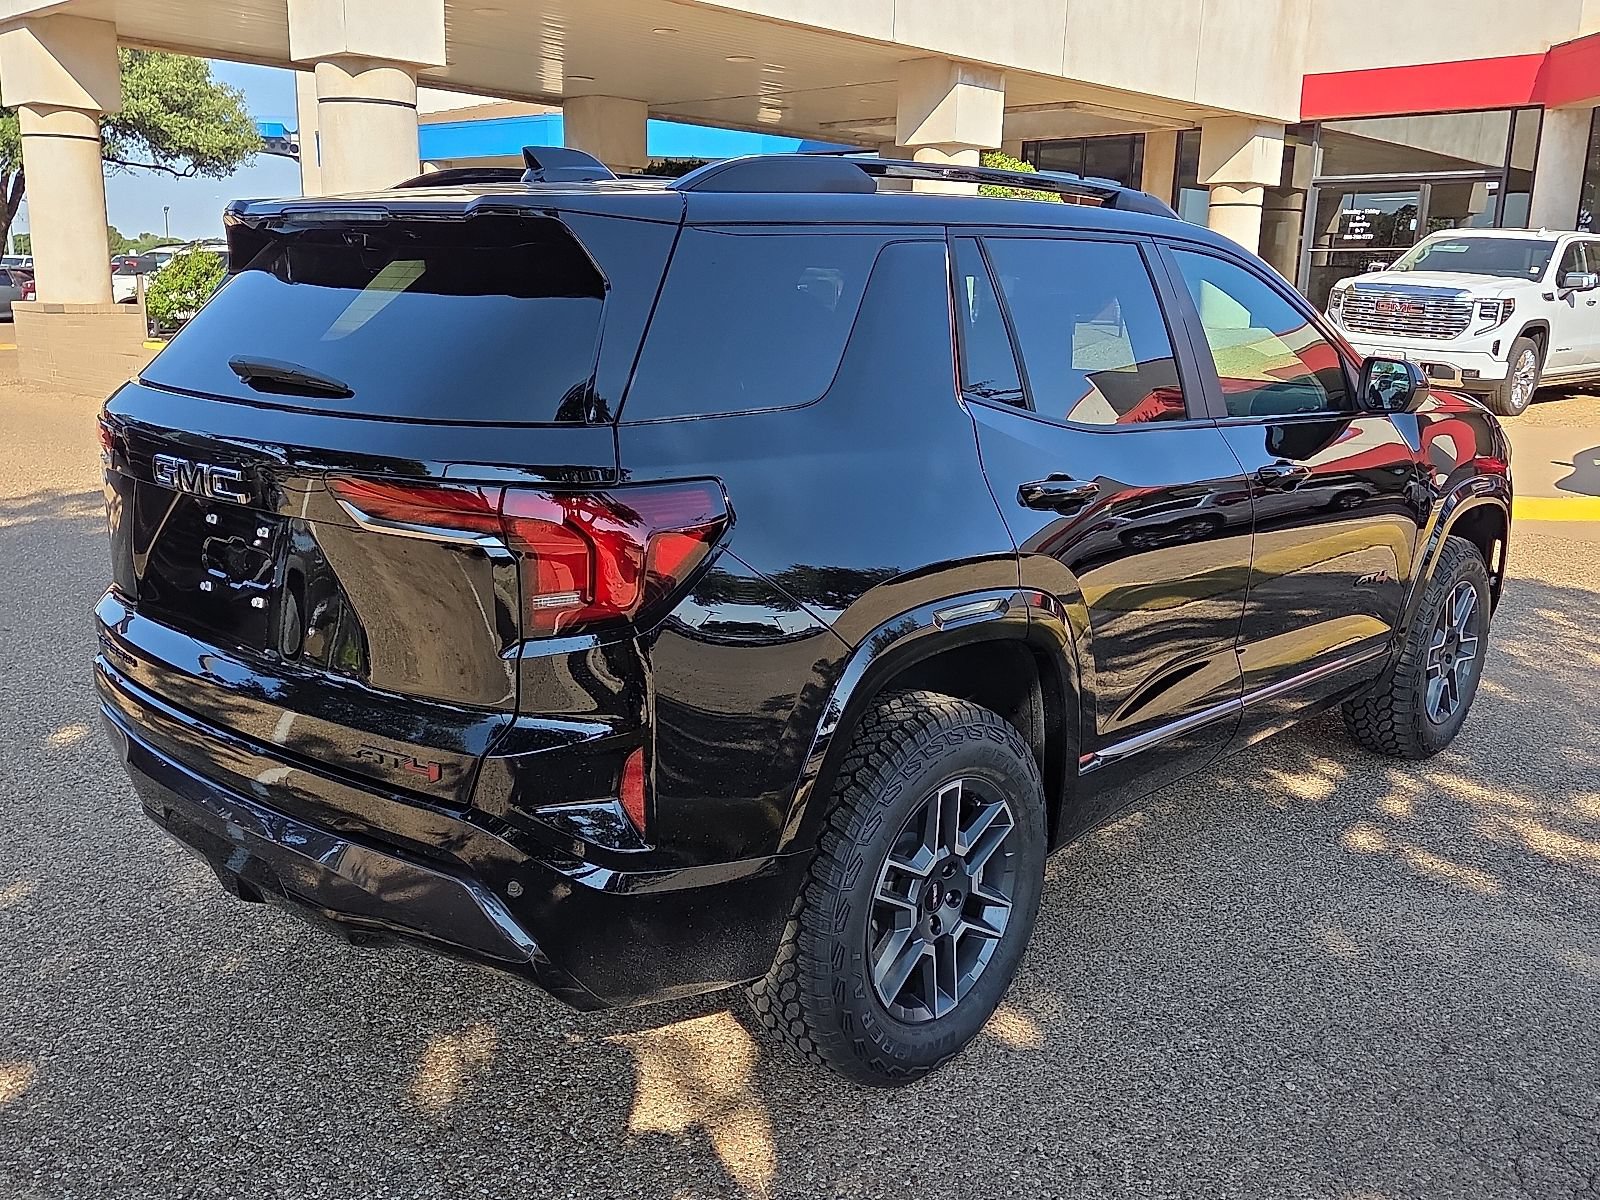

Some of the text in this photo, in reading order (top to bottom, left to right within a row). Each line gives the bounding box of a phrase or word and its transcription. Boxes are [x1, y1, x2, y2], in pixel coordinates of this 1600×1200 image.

[1376, 300, 1424, 315] GMC
[152, 453, 247, 505] GMC
[1353, 569, 1389, 587] AT4
[350, 743, 443, 784] AT4
